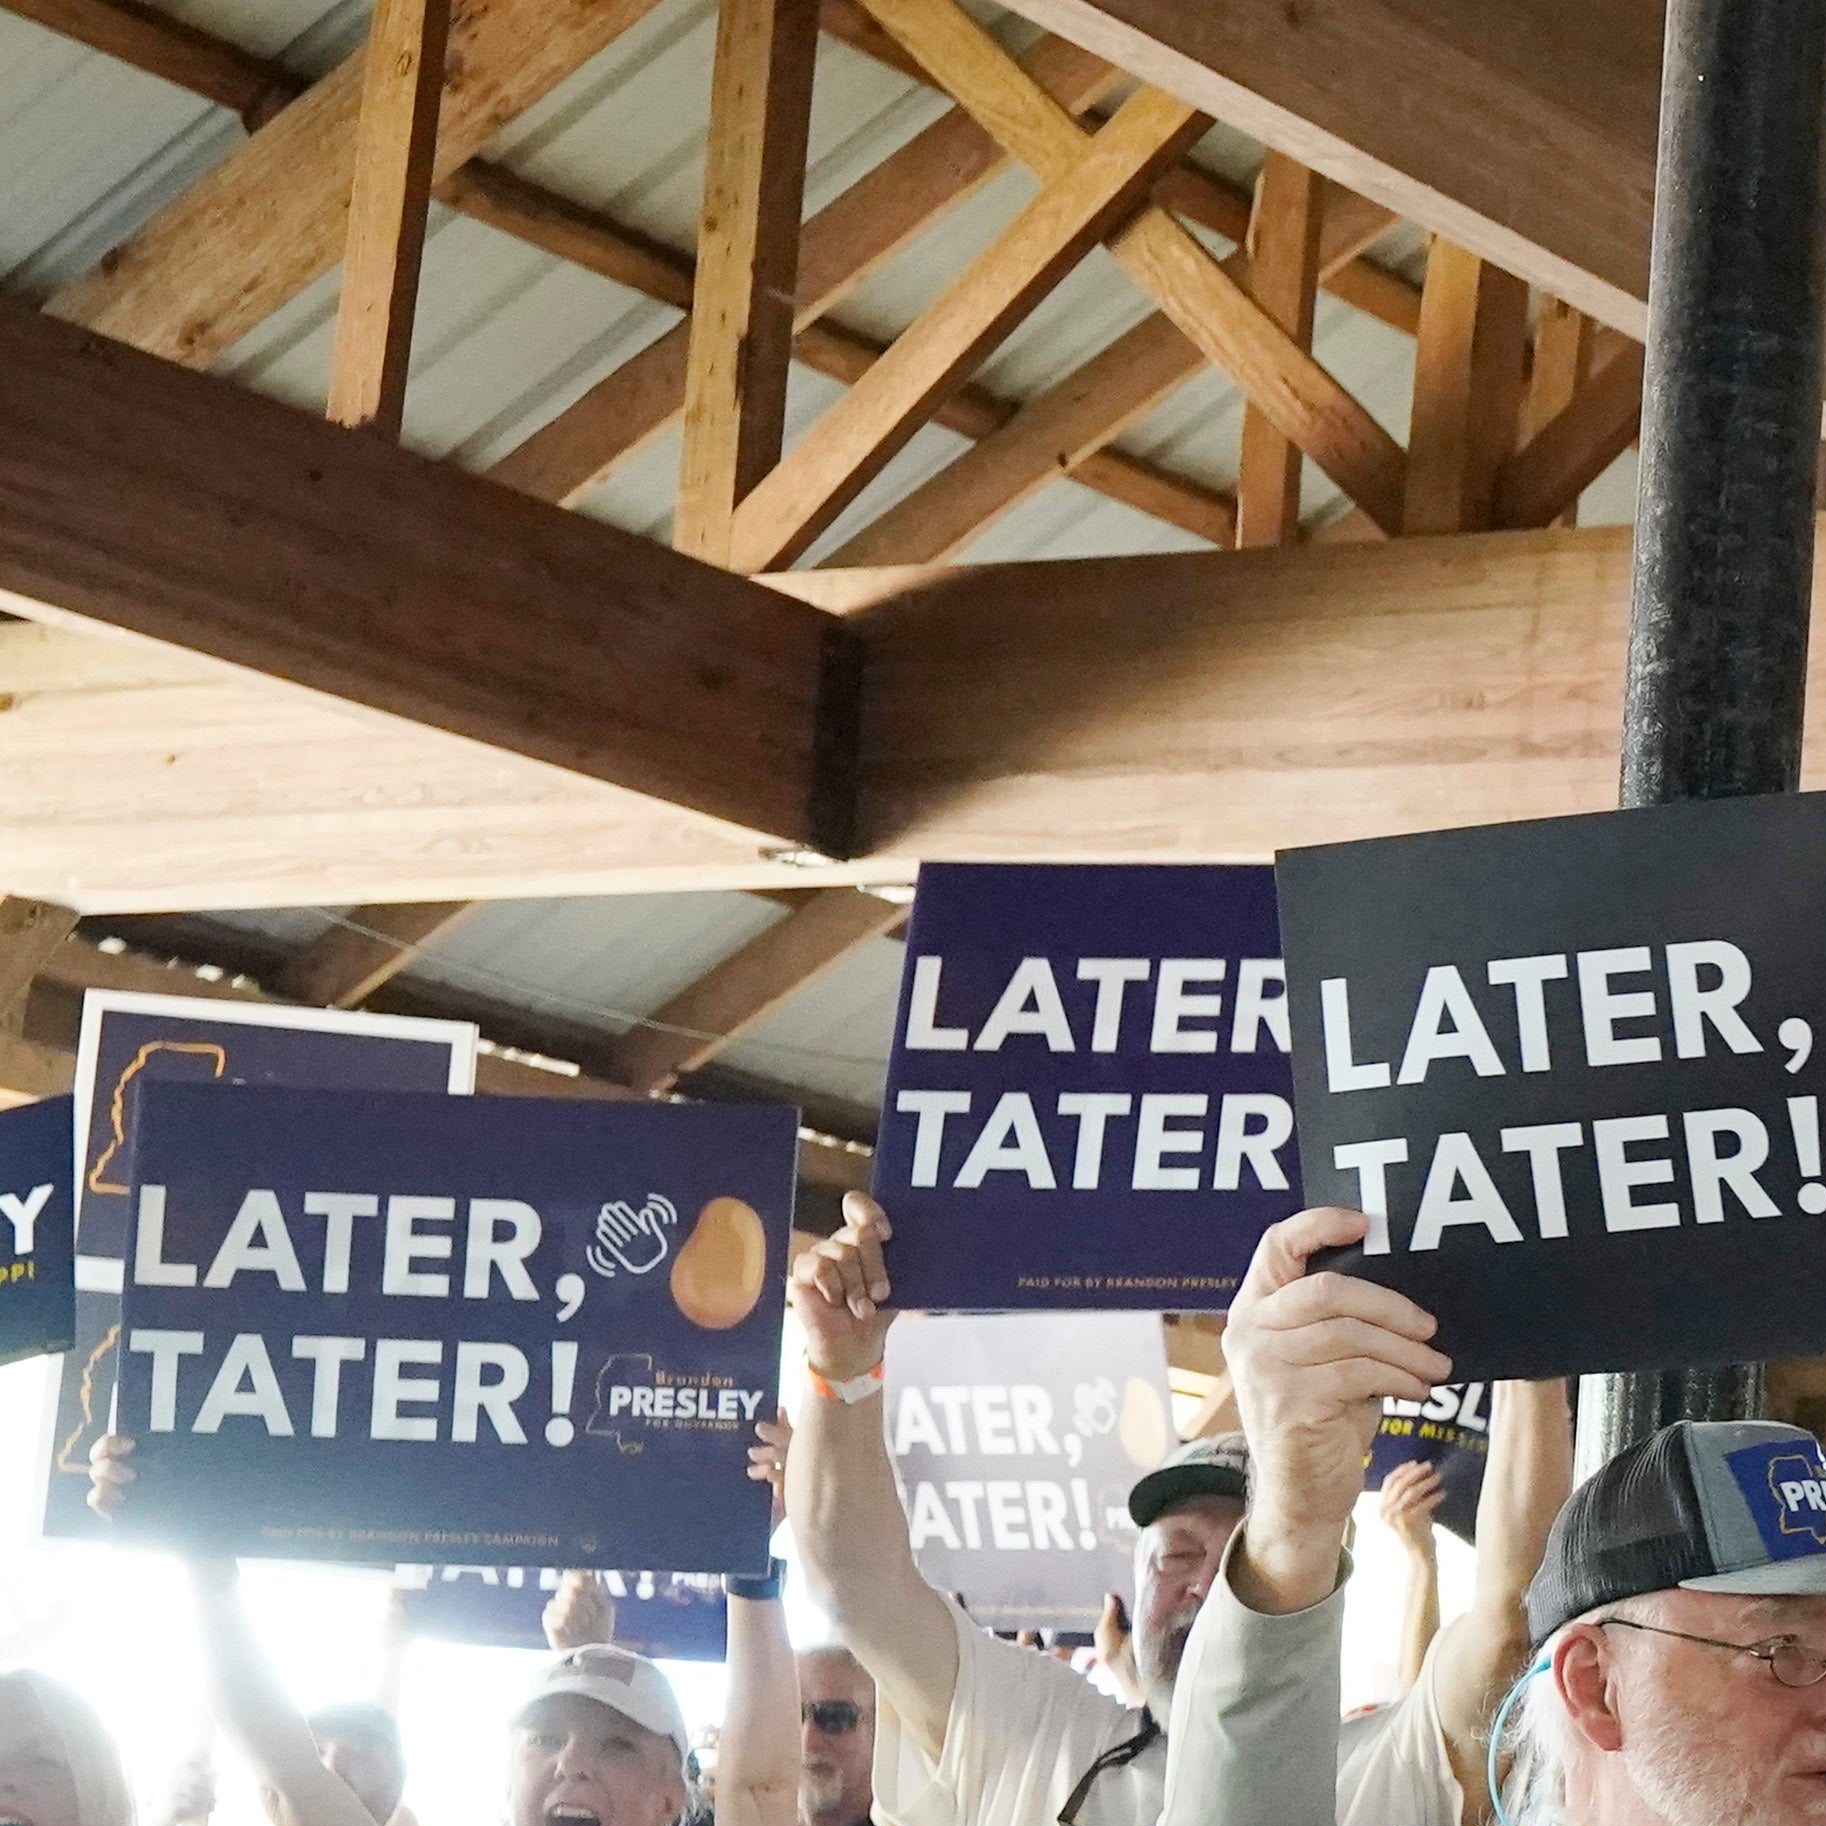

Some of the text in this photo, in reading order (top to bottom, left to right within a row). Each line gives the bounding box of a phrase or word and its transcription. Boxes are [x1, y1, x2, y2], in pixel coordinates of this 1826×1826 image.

[1320, 938, 1813, 1094] LATER,
[133, 1184, 585, 1322] LATER,
[130, 1329, 579, 1447] TATER!
[609, 1385, 765, 1421] PRESLEY
[894, 1383, 1082, 1467] ATER,
[910, 1477, 1098, 1551] ATER!
